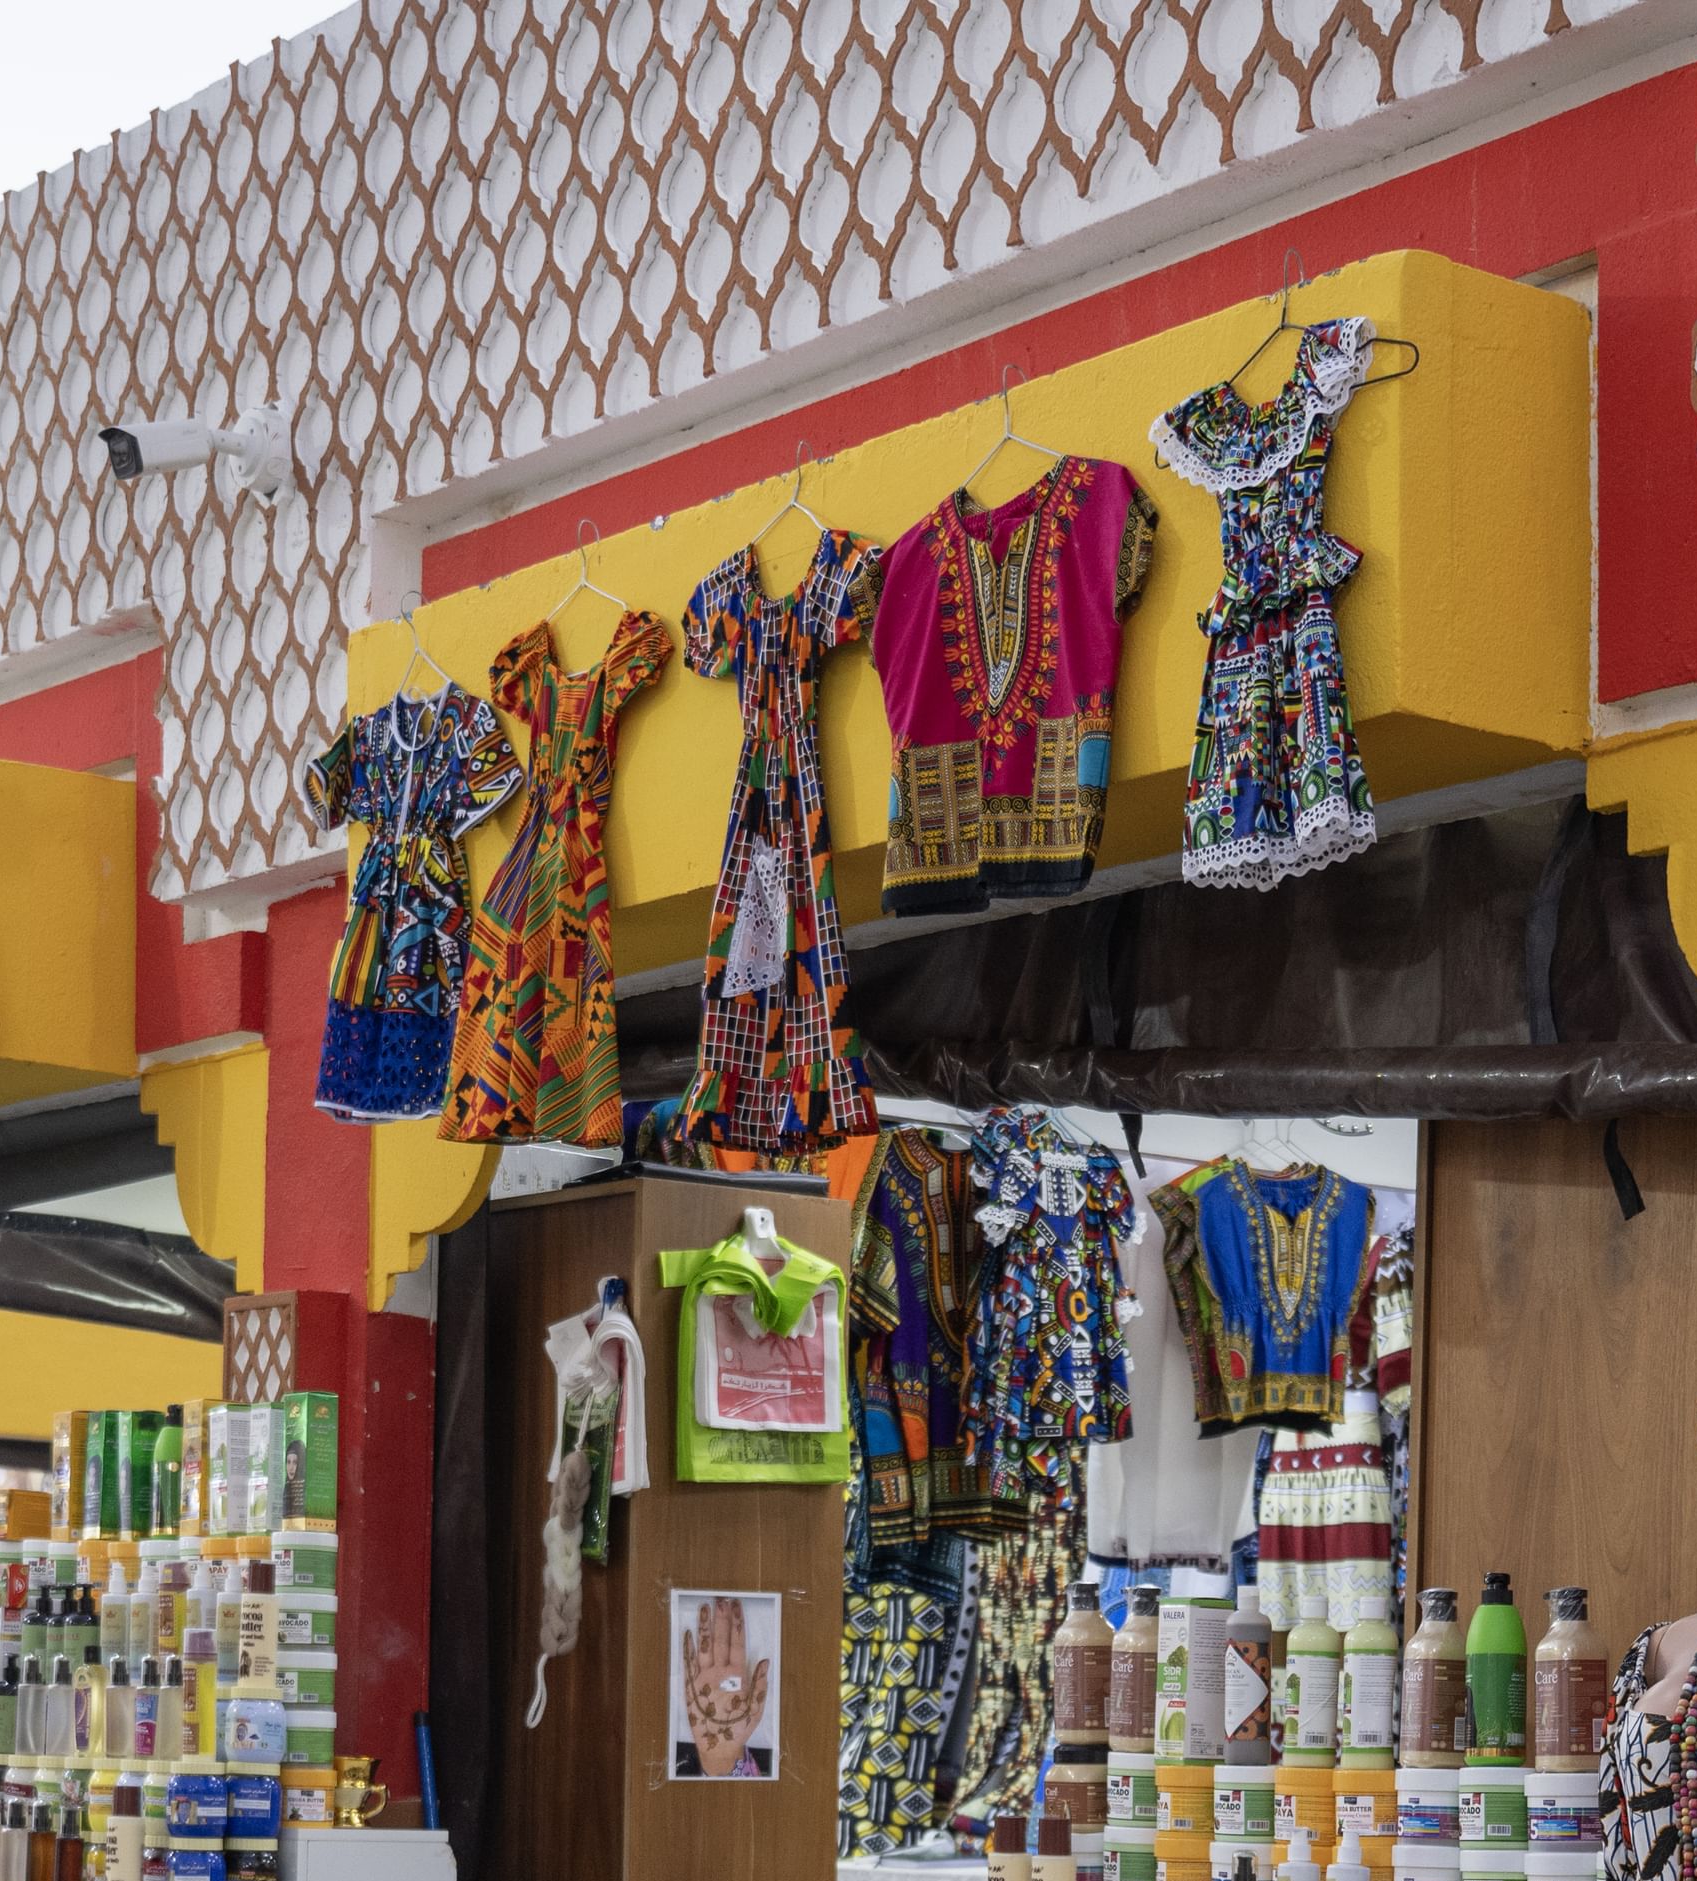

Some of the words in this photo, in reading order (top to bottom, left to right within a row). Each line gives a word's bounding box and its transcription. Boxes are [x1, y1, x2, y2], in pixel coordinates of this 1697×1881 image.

[1162, 1611, 1185, 1620] VALERA
[1163, 1667, 1182, 1676] SIDR
[1530, 1820, 1538, 1840] 5
